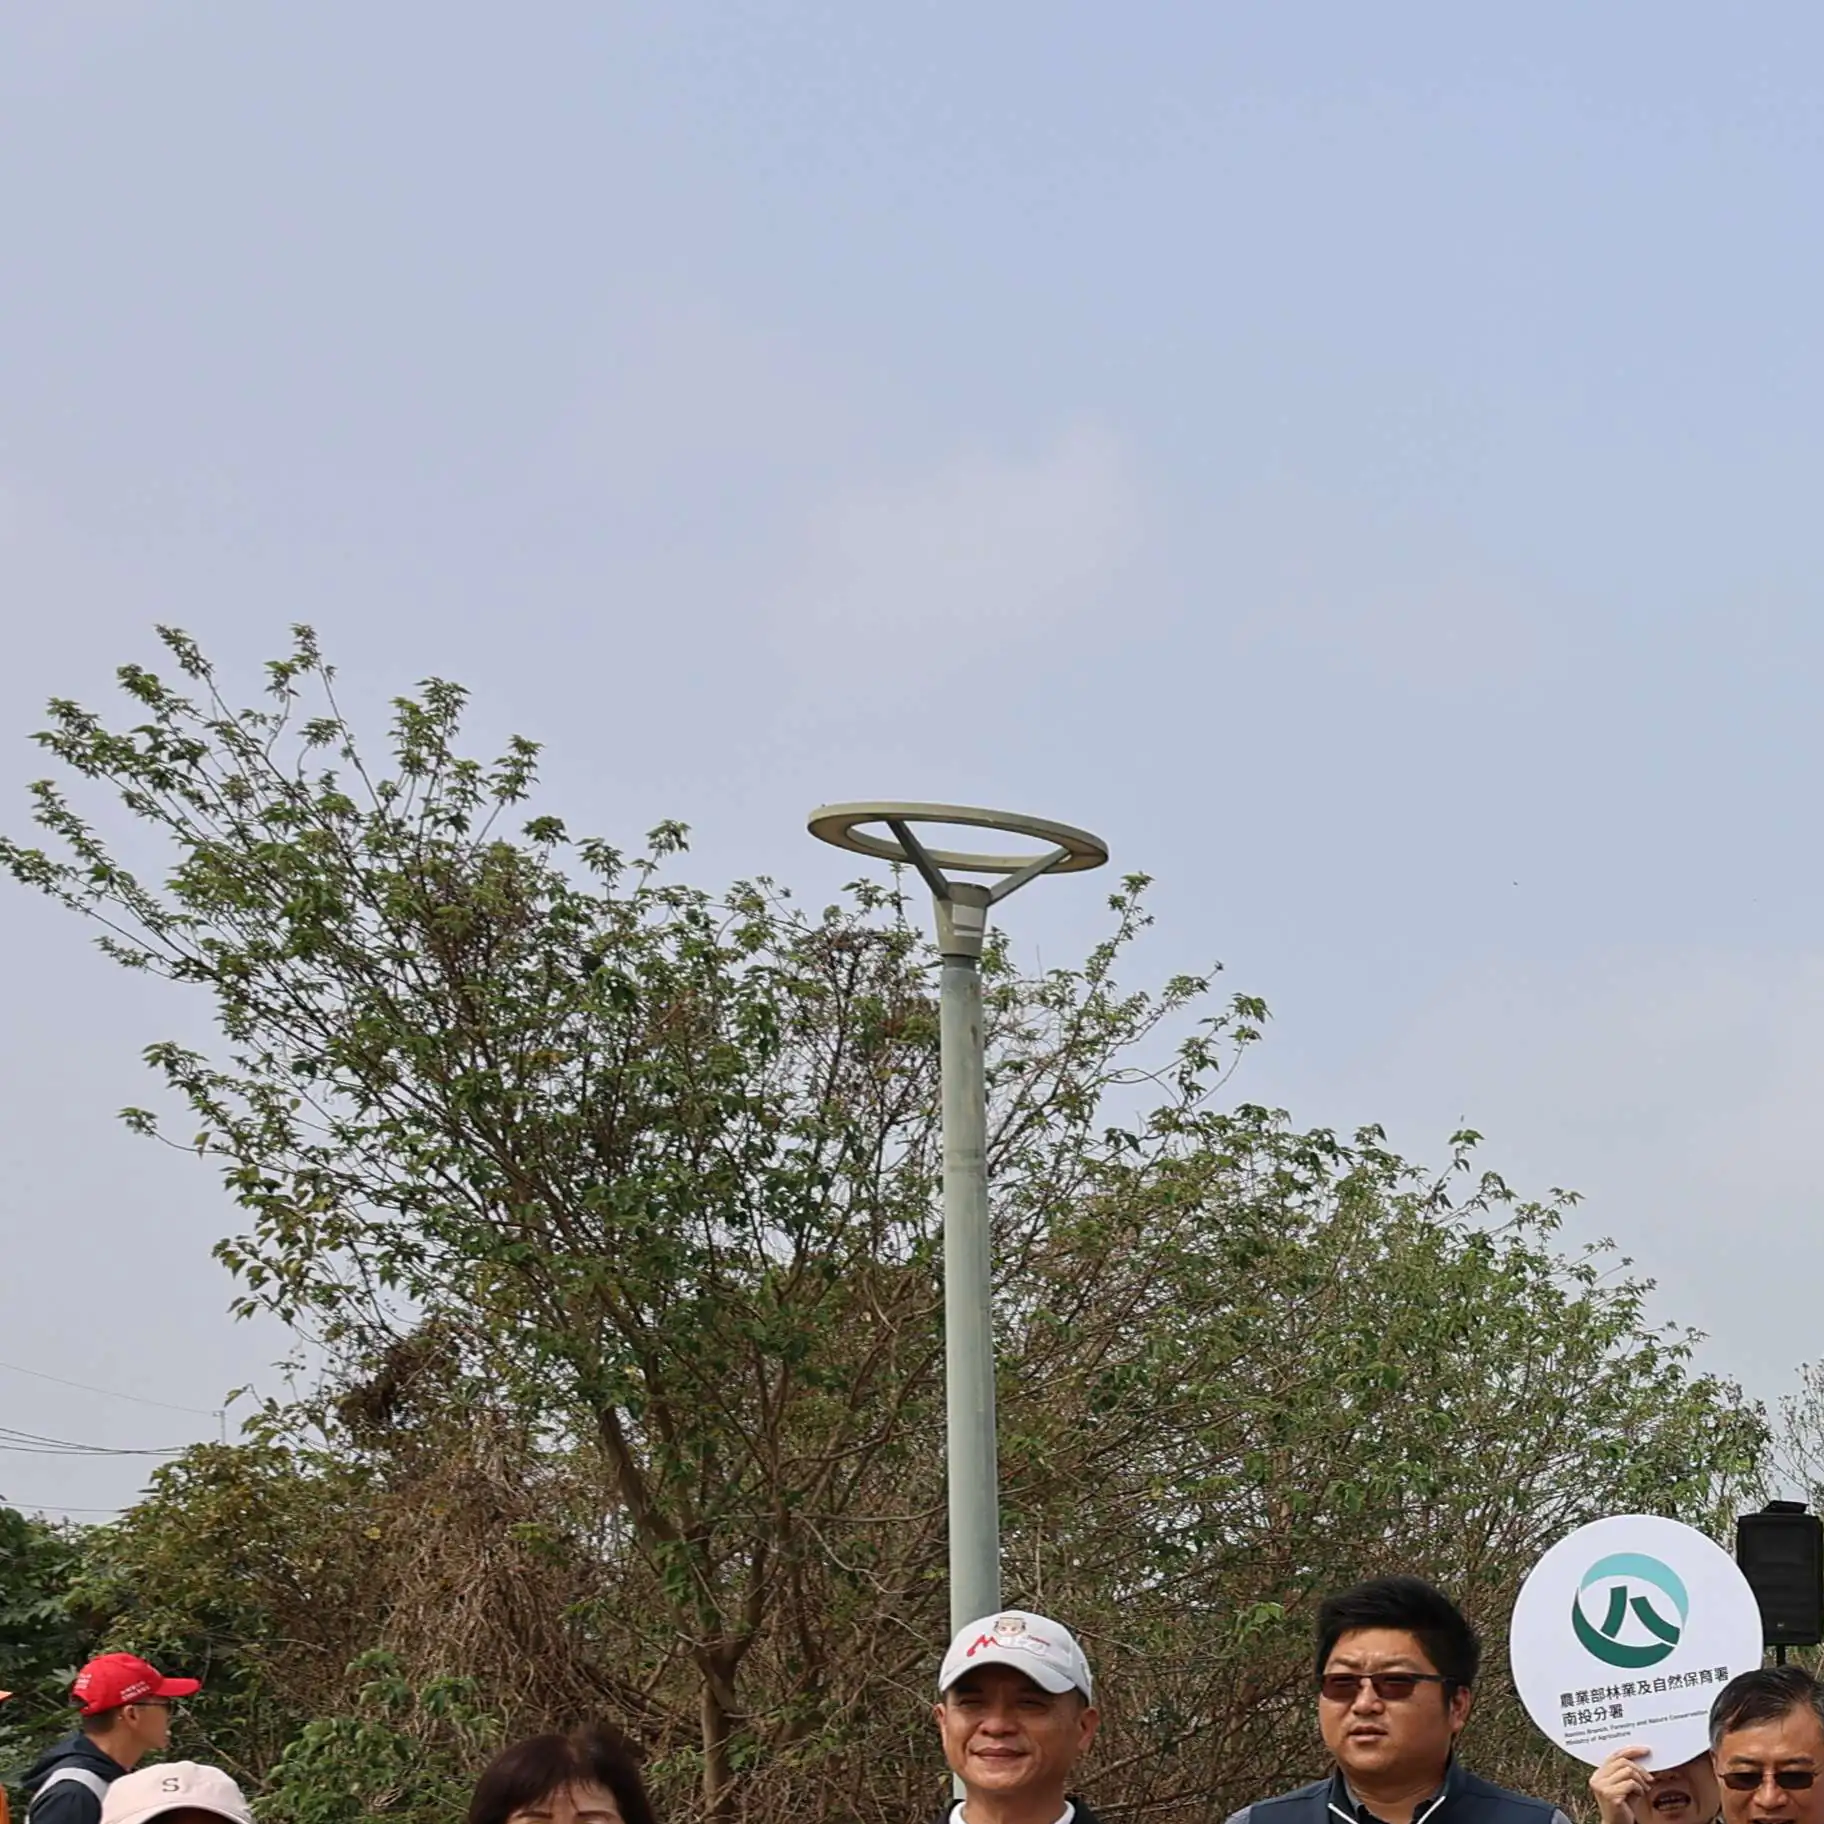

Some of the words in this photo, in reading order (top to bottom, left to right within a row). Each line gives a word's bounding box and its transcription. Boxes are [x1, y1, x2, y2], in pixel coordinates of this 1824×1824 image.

[1560, 1666, 1729, 1709] 農業部林業及自然保育署
[1562, 1703, 1624, 1728] 南投分署
[162, 1777, 180, 1793] S
